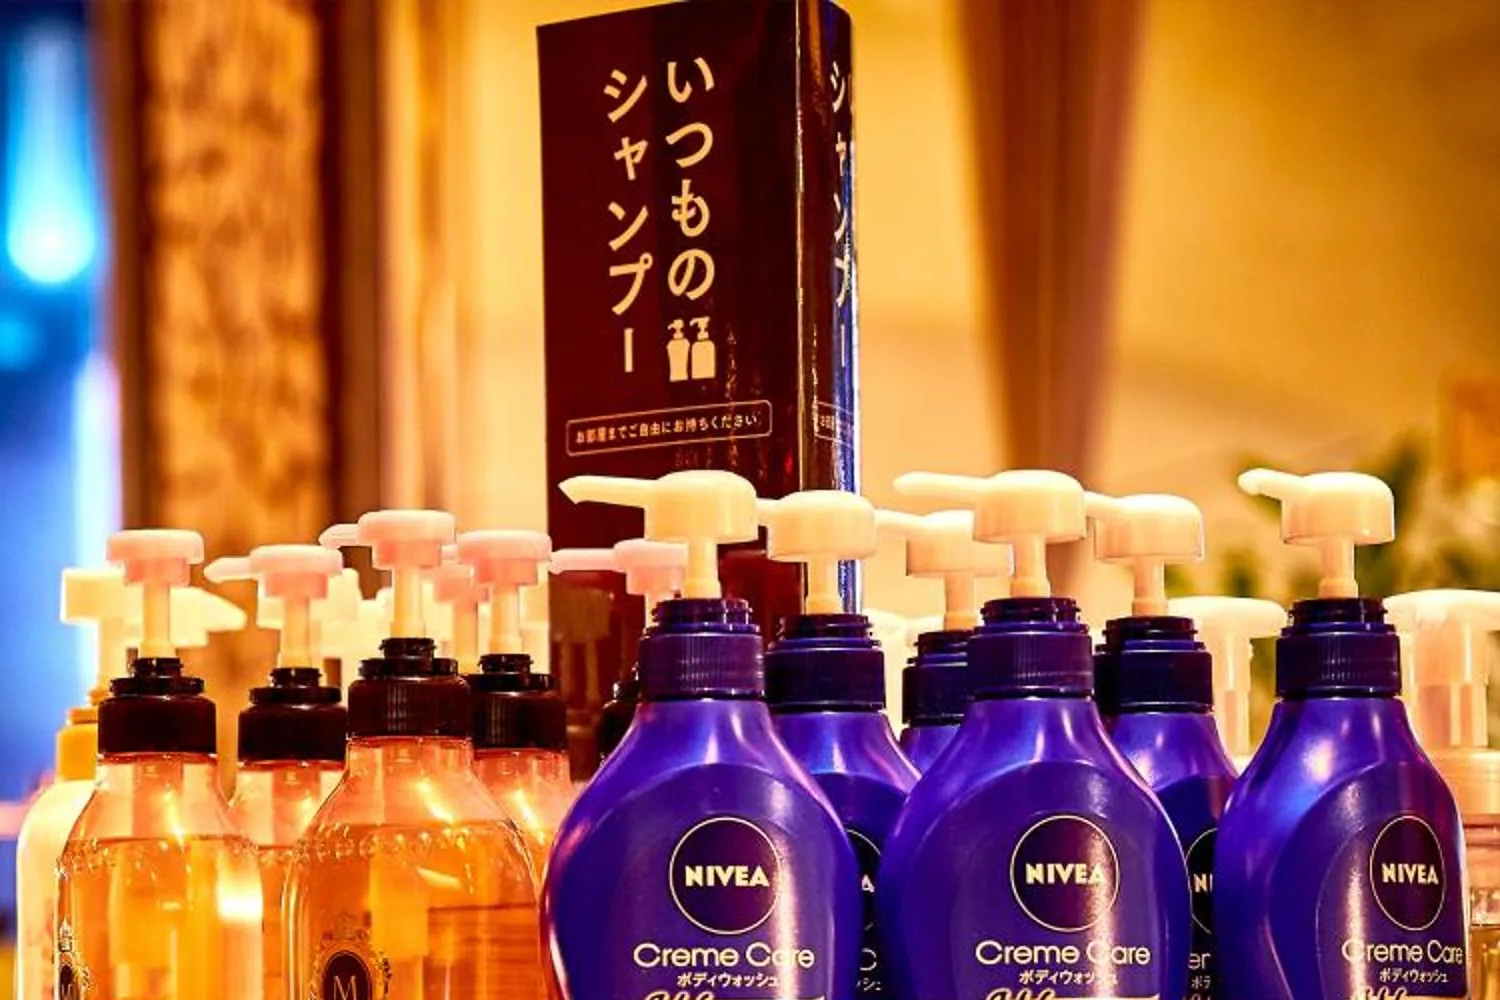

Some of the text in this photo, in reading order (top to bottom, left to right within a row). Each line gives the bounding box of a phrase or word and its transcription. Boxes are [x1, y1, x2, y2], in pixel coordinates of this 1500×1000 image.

[665, 56, 716, 302] いつもの
[603, 68, 653, 374] シャンプー
[684, 865, 770, 888] NIVEA
[1025, 862, 1104, 885] NIVEA
[1382, 862, 1440, 885] NIVEA
[633, 941, 815, 968] Creme Care
[975, 940, 1151, 965] Creme Care
[1341, 938, 1464, 965] Creme Care
[676, 972, 781, 988] ボディウォッシュ
